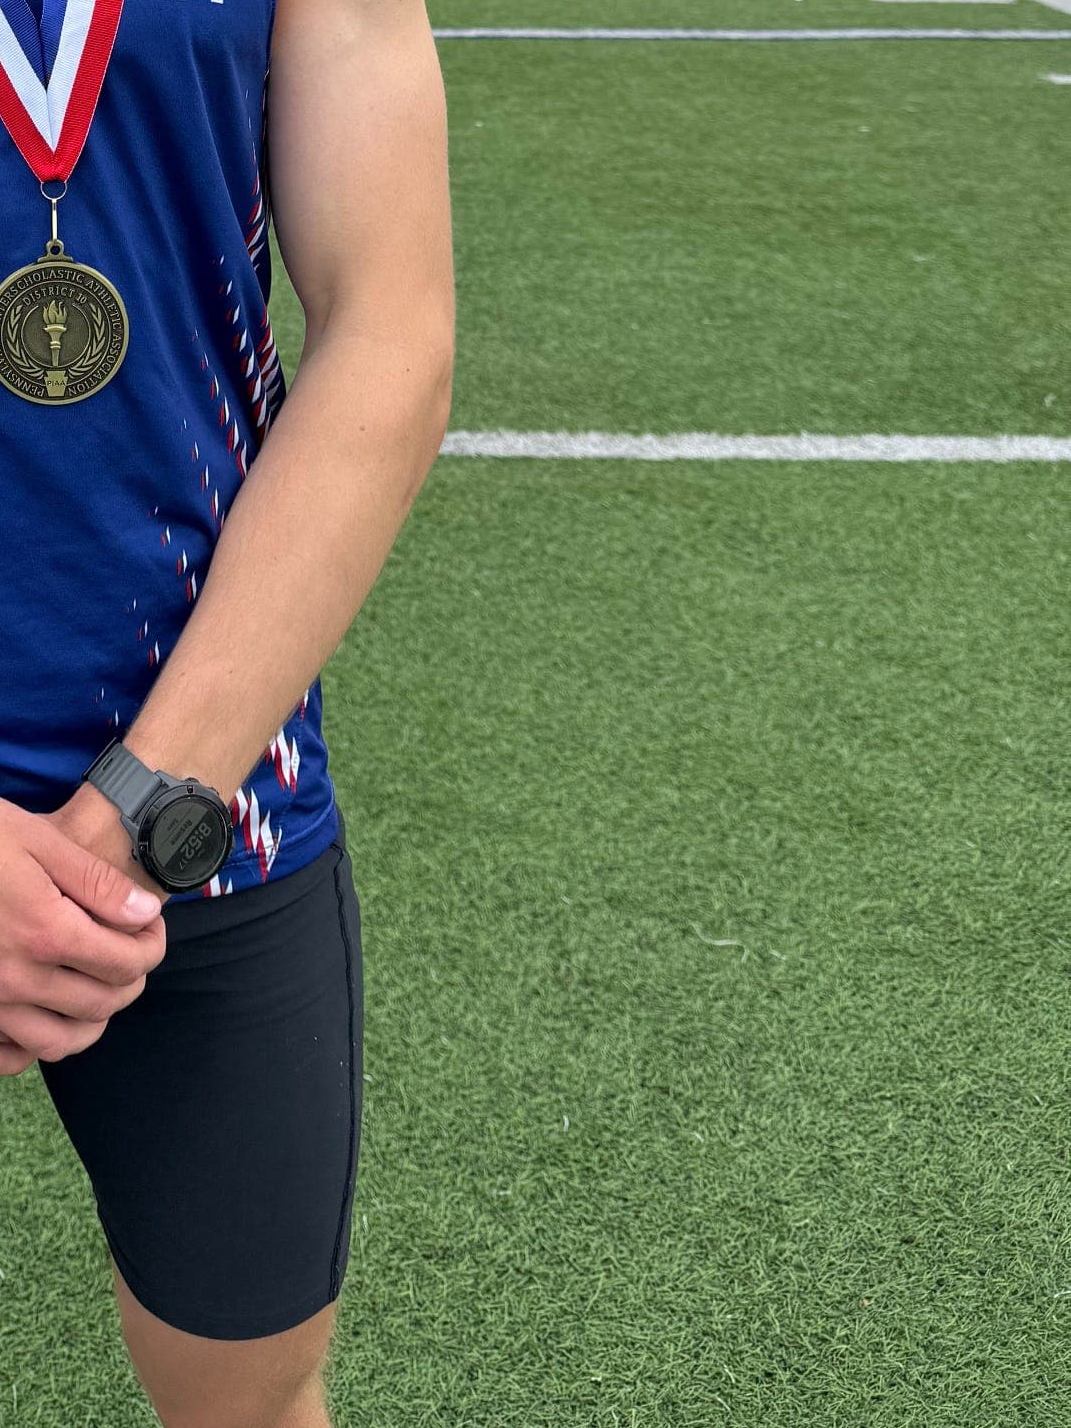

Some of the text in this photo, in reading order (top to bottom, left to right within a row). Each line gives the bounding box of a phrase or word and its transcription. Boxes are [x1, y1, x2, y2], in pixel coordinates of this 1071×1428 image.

[22, 286, 88, 306] DISTRICT 10
[85, 280, 122, 330] ATHLETIC
[46, 379, 66, 387] PIAA
[68, 334, 122, 397] ASSOCIATION
[180, 822, 212, 859] 8:52
